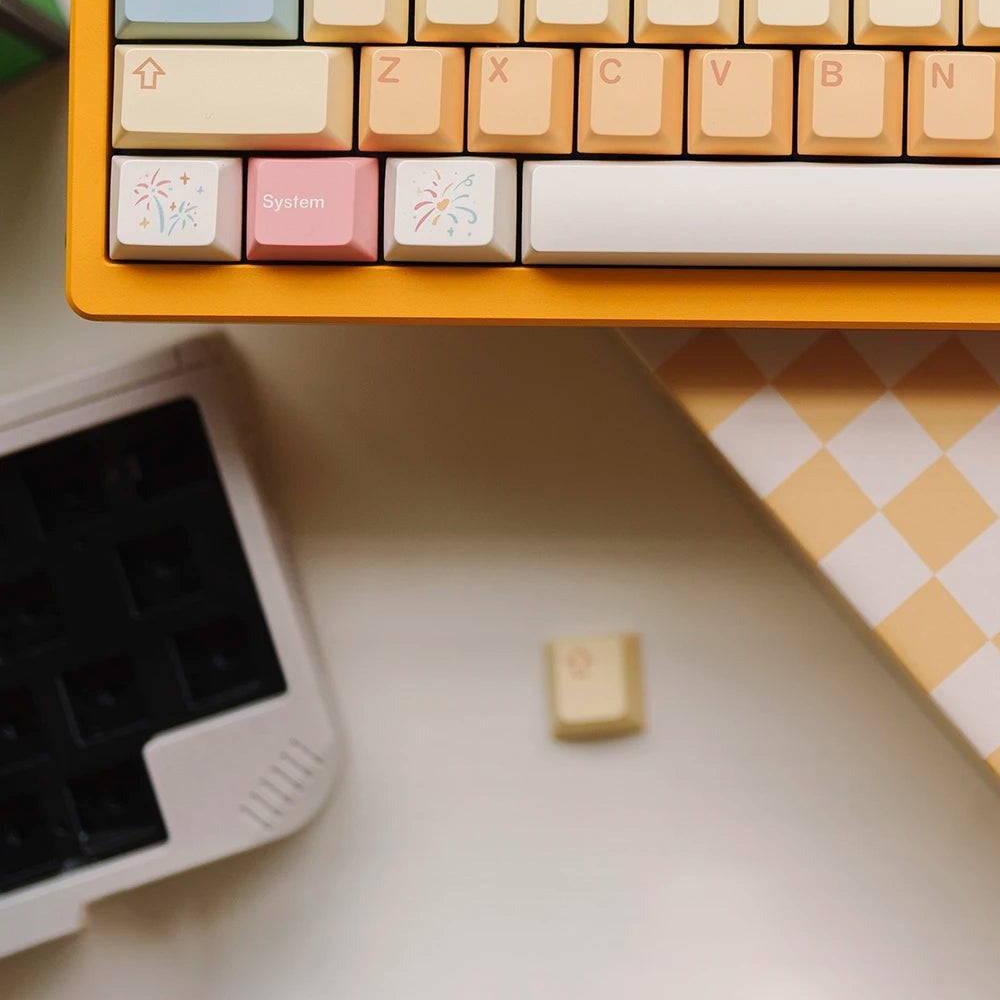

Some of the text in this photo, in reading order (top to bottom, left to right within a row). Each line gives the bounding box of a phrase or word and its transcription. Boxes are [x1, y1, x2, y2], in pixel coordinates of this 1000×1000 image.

[377, 56, 400, 83] Z
[488, 57, 509, 83] X
[599, 58, 622, 85] C
[710, 59, 731, 86] V
[821, 60, 843, 87] B
[931, 62, 954, 89] N
[262, 193, 325, 211] System
